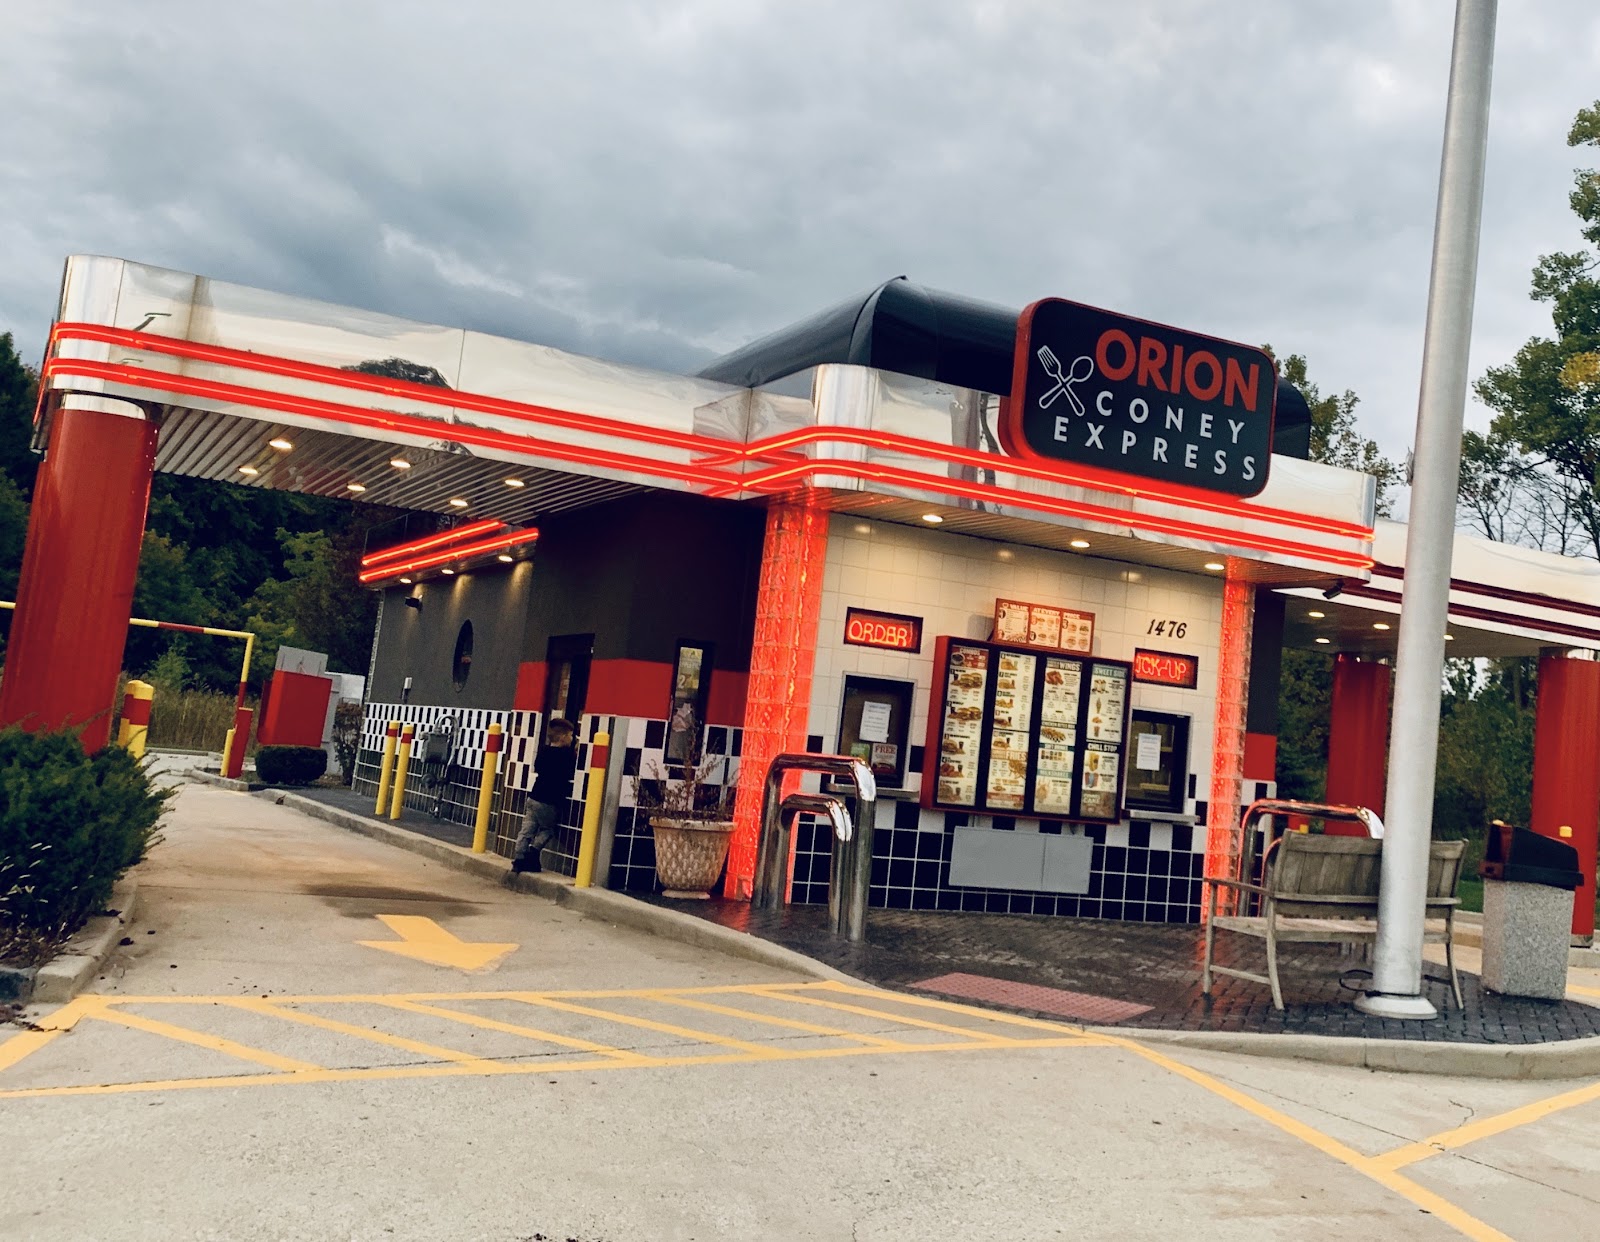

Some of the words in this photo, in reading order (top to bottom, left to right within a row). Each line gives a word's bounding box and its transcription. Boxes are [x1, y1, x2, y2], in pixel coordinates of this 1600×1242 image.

[1096, 329, 1260, 411] ORION
[1096, 391, 1245, 444] CONEY
[1053, 416, 1256, 481] EXPRESS
[848, 620, 908, 647] ORDER
[1146, 619, 1187, 639] 1476
[1060, 661, 1081, 672] WINGS
[1135, 655, 1187, 680] ICK-UP
[875, 744, 896, 754] FREE
[1006, 752, 1027, 760] FRIES
[1103, 744, 1118, 752] STOP
